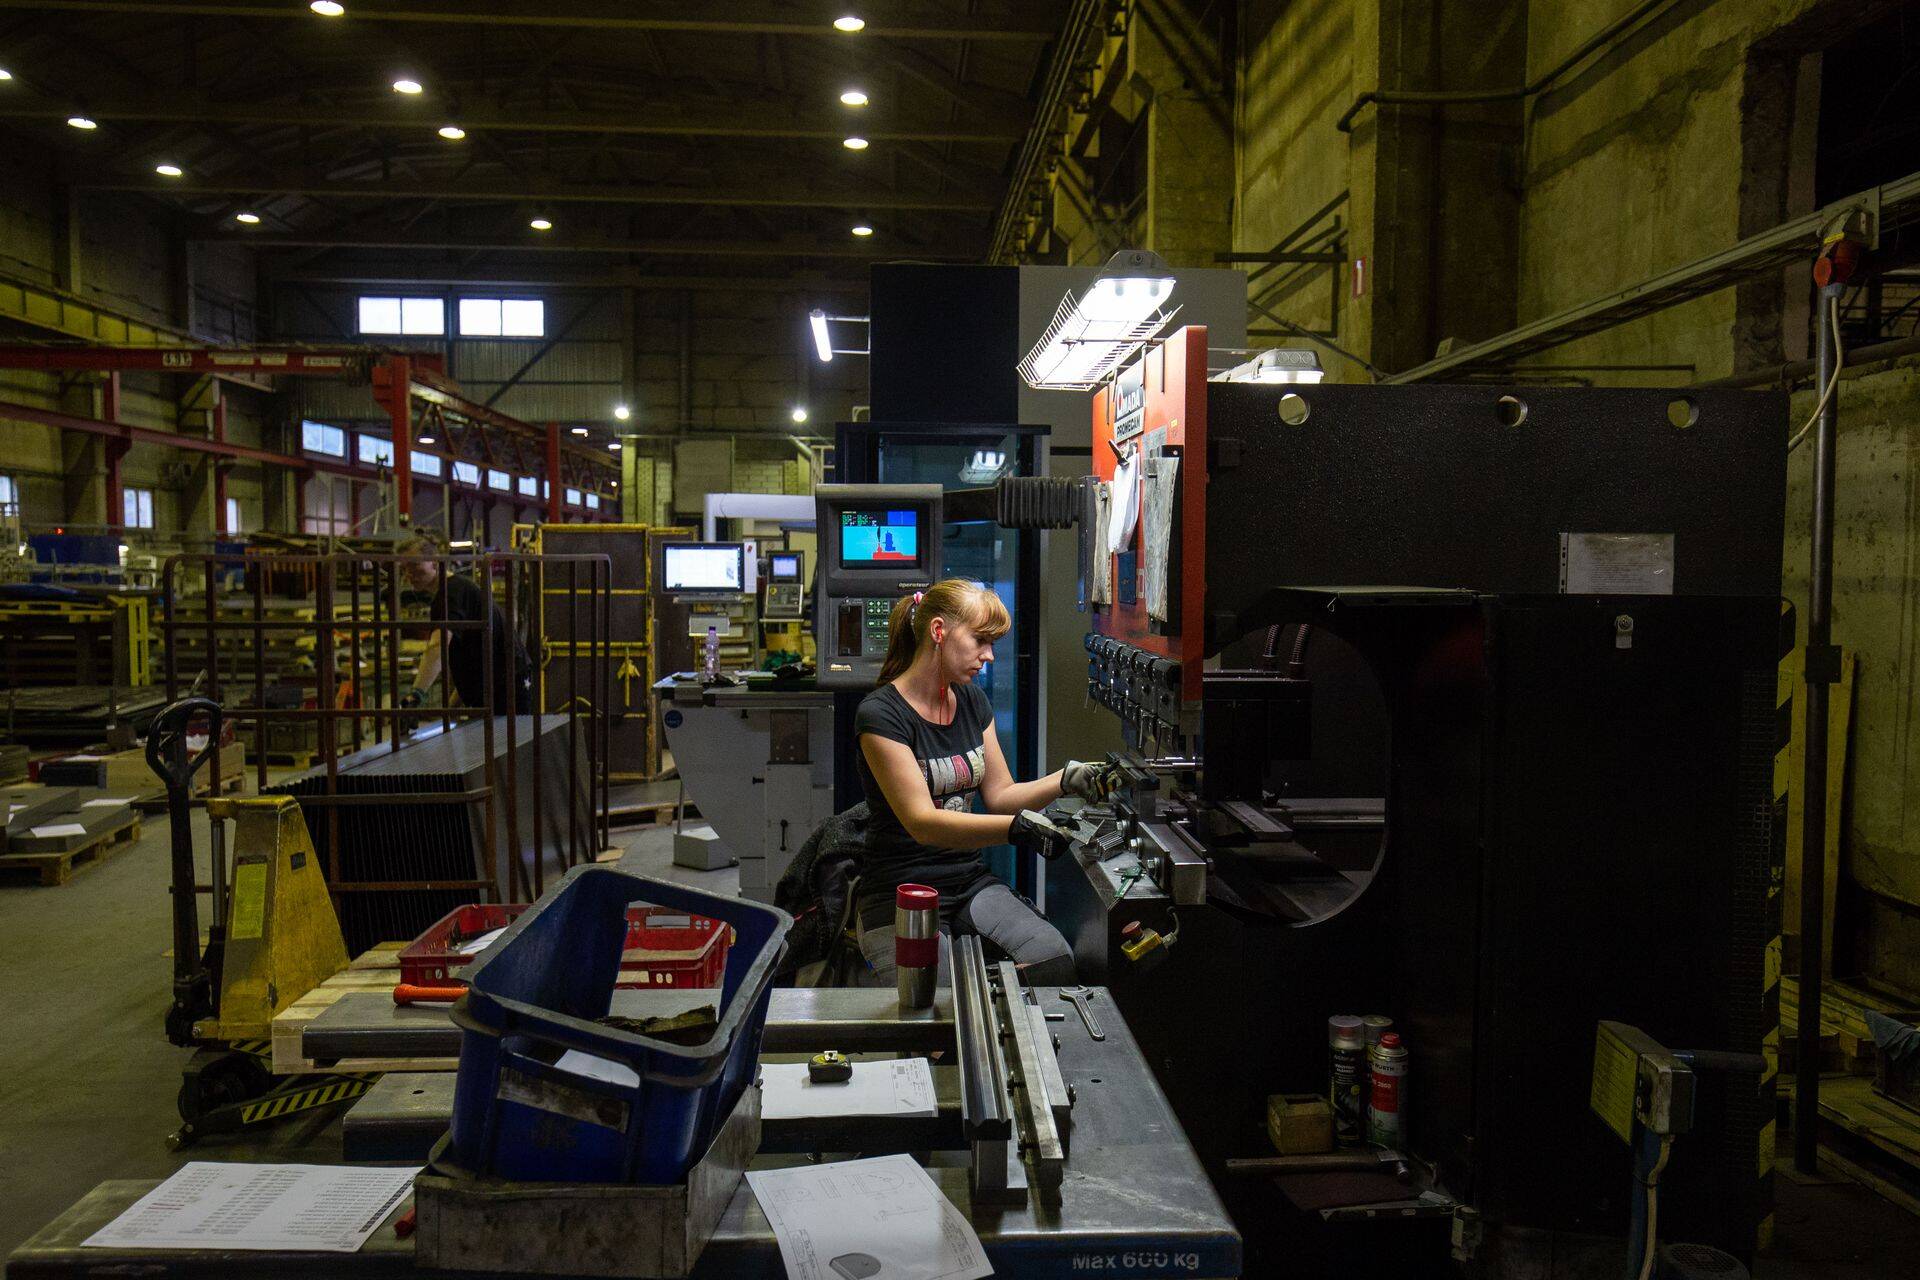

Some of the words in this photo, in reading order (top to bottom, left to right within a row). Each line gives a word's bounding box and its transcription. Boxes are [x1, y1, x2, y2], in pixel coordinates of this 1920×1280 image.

[1073, 1253, 1116, 1269] Max
[1122, 1252, 1168, 1268] 600
[1174, 1253, 1199, 1271] kg
